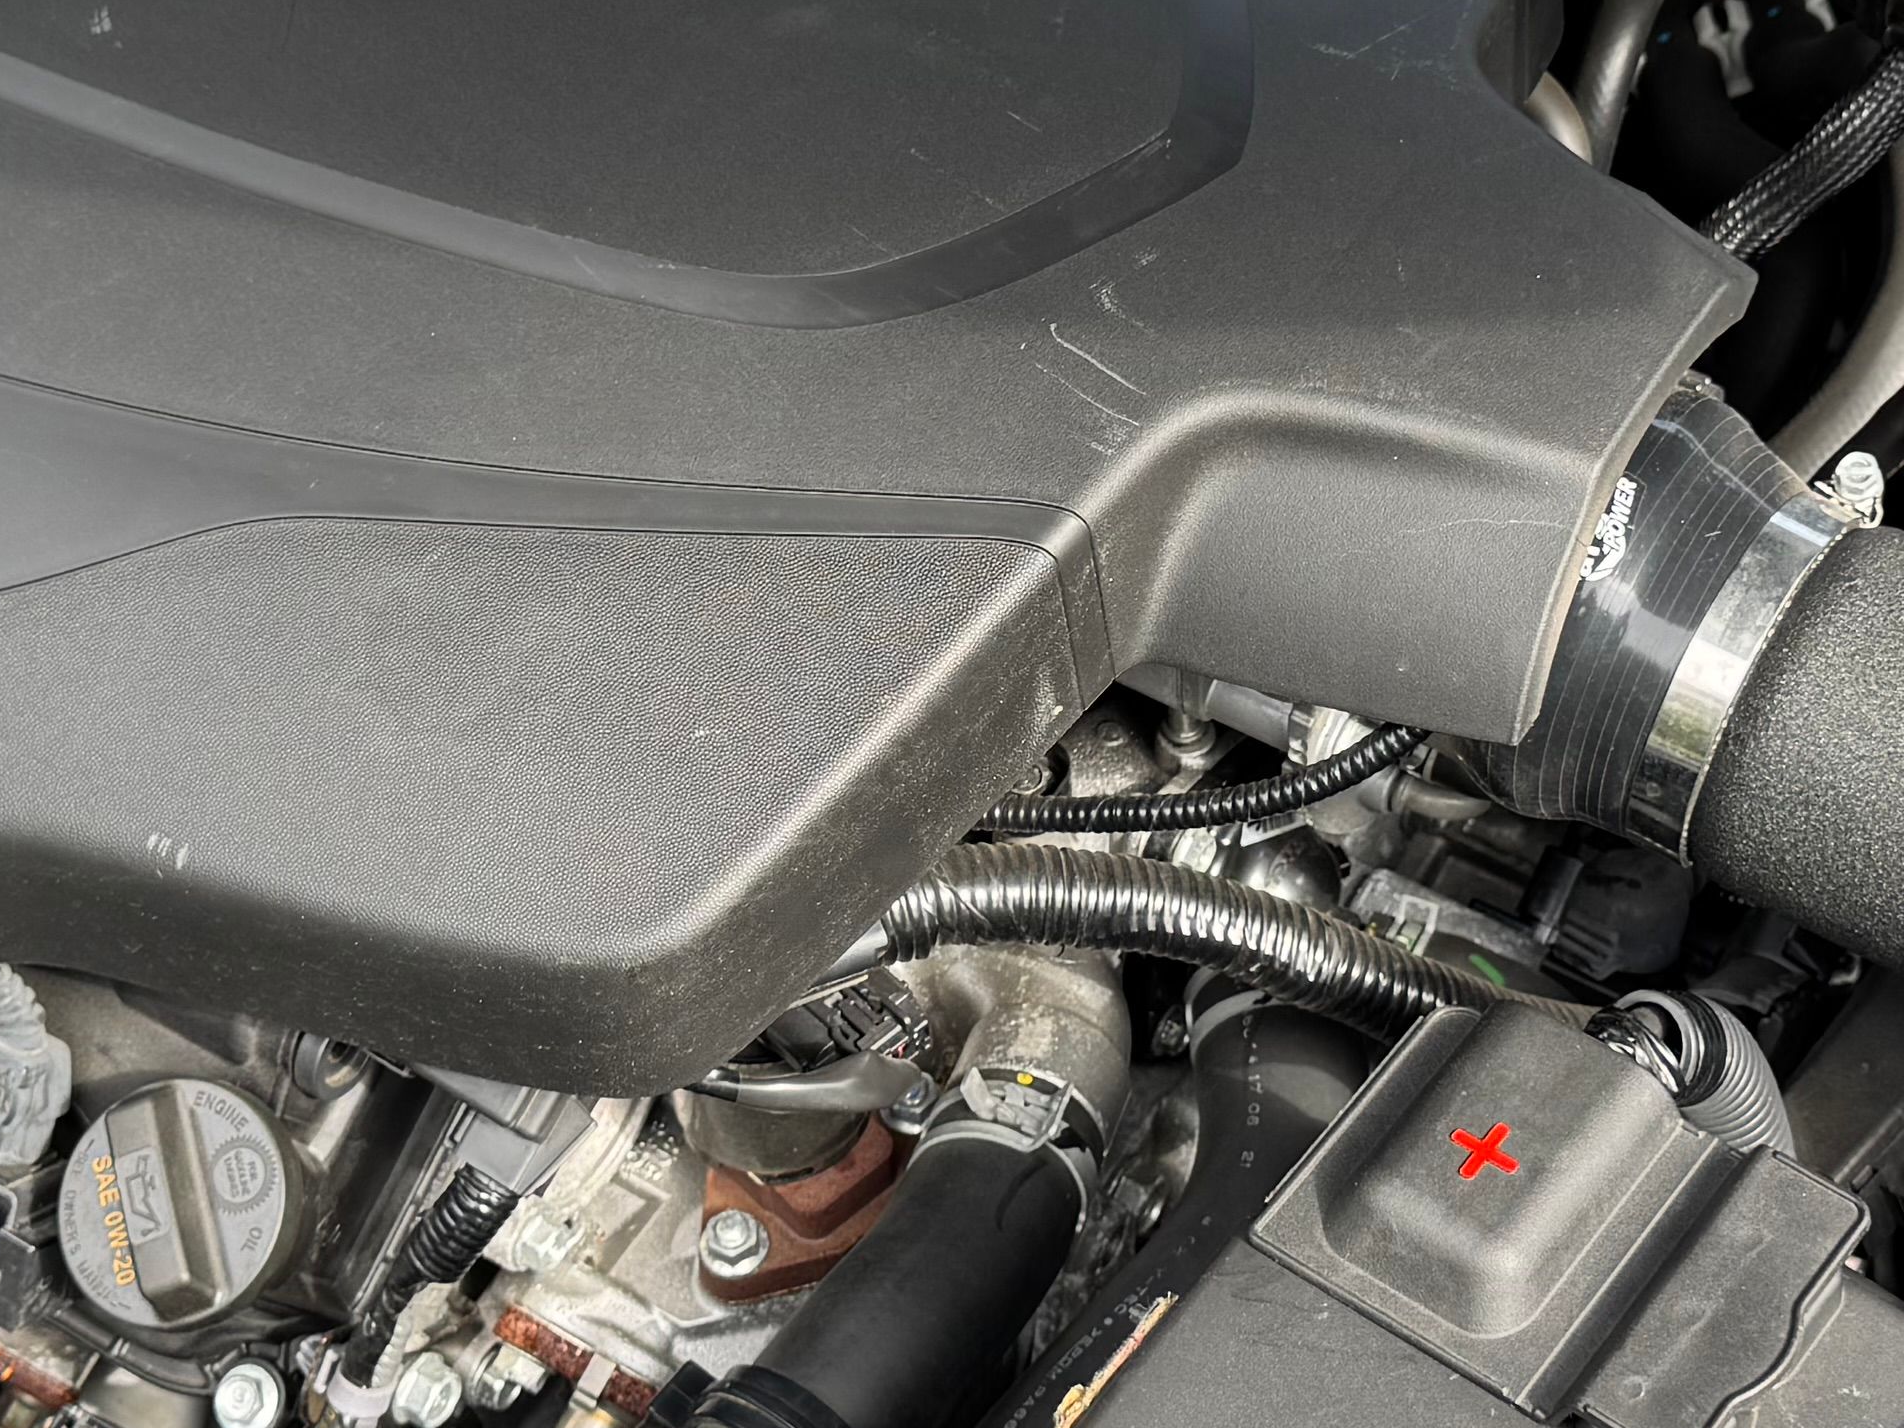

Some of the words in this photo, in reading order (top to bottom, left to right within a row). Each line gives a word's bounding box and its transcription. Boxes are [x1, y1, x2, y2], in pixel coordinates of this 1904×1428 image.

[1603, 476, 1637, 552] POWER
[194, 1090, 249, 1133] ENGINE
[92, 1154, 119, 1207] SAE
[103, 1211, 136, 1287] 0W-20
[241, 1226, 263, 1253] OIL
